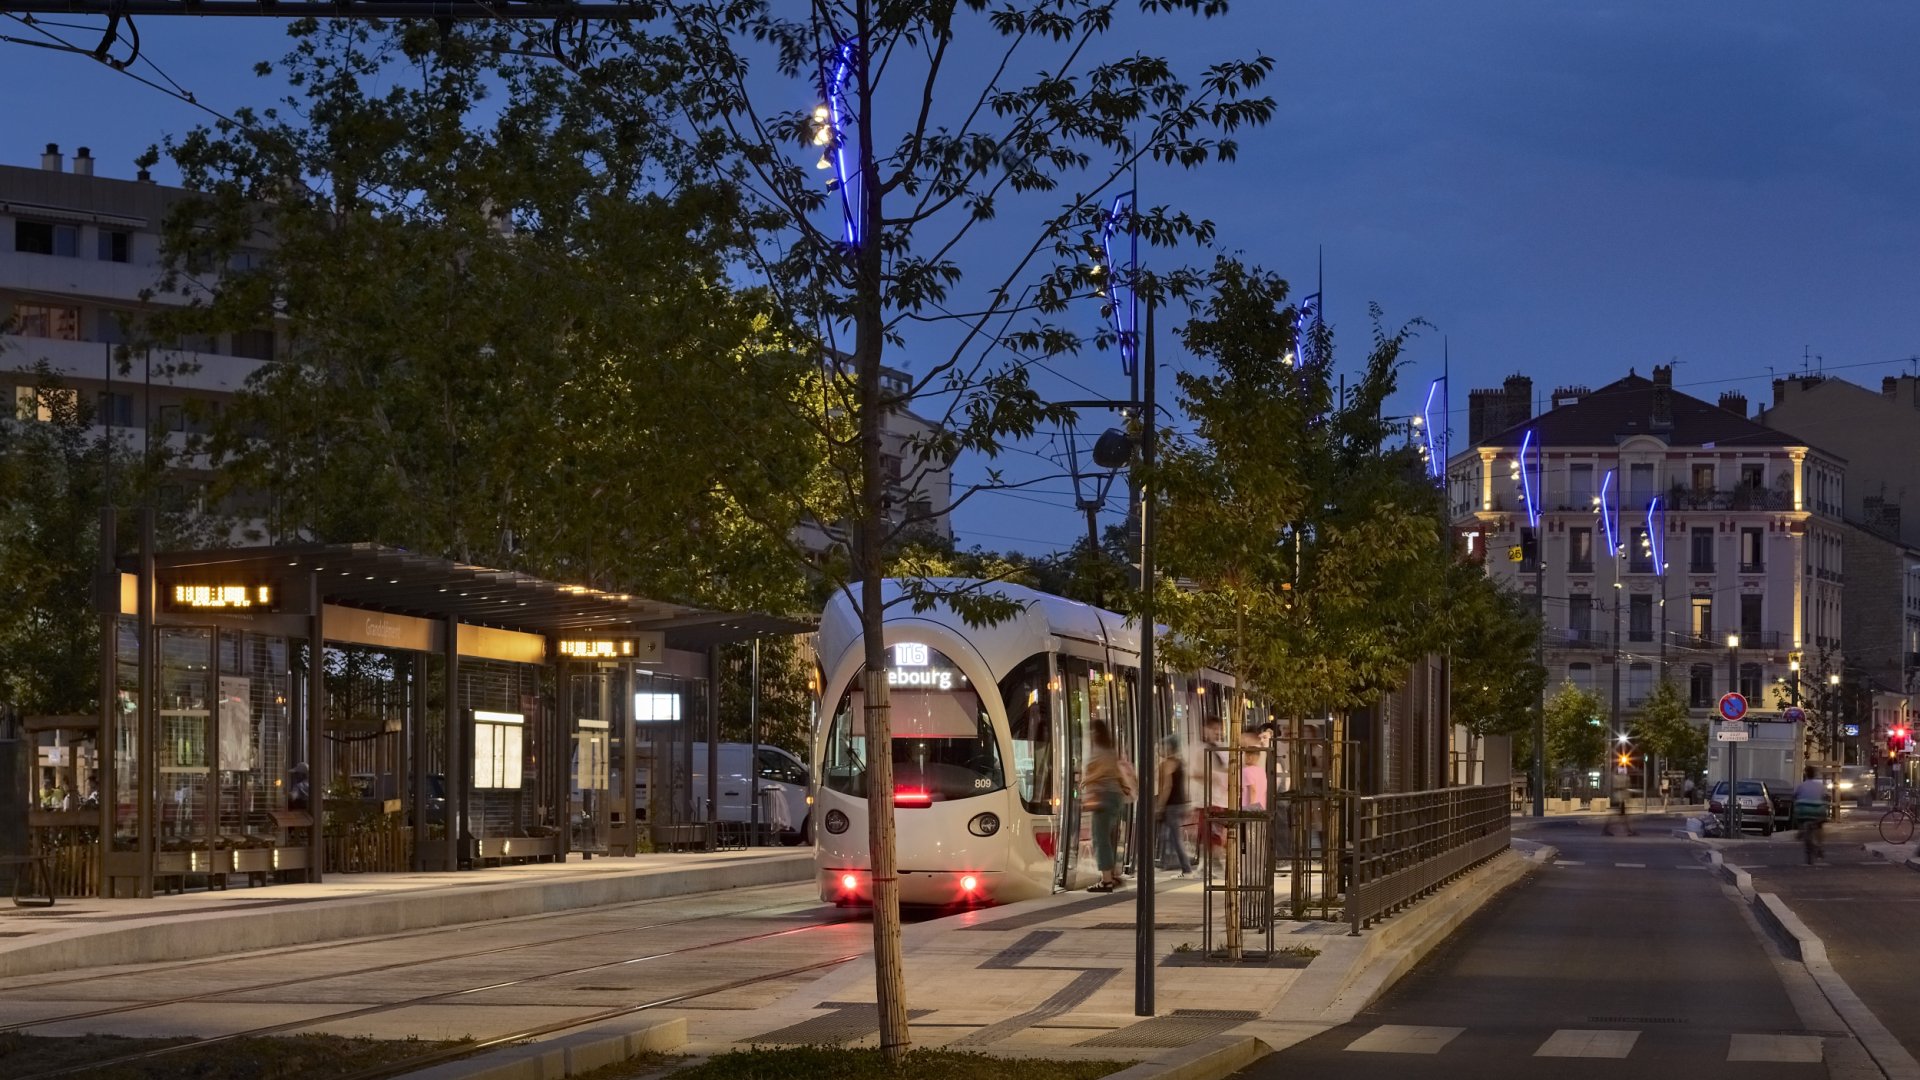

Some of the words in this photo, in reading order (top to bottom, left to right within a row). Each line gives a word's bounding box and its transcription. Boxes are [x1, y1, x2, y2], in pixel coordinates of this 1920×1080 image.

[1508, 549, 1522, 560] 25
[898, 644, 925, 663] T6
[888, 667, 952, 690] ebourg
[975, 779, 991, 788] 809
